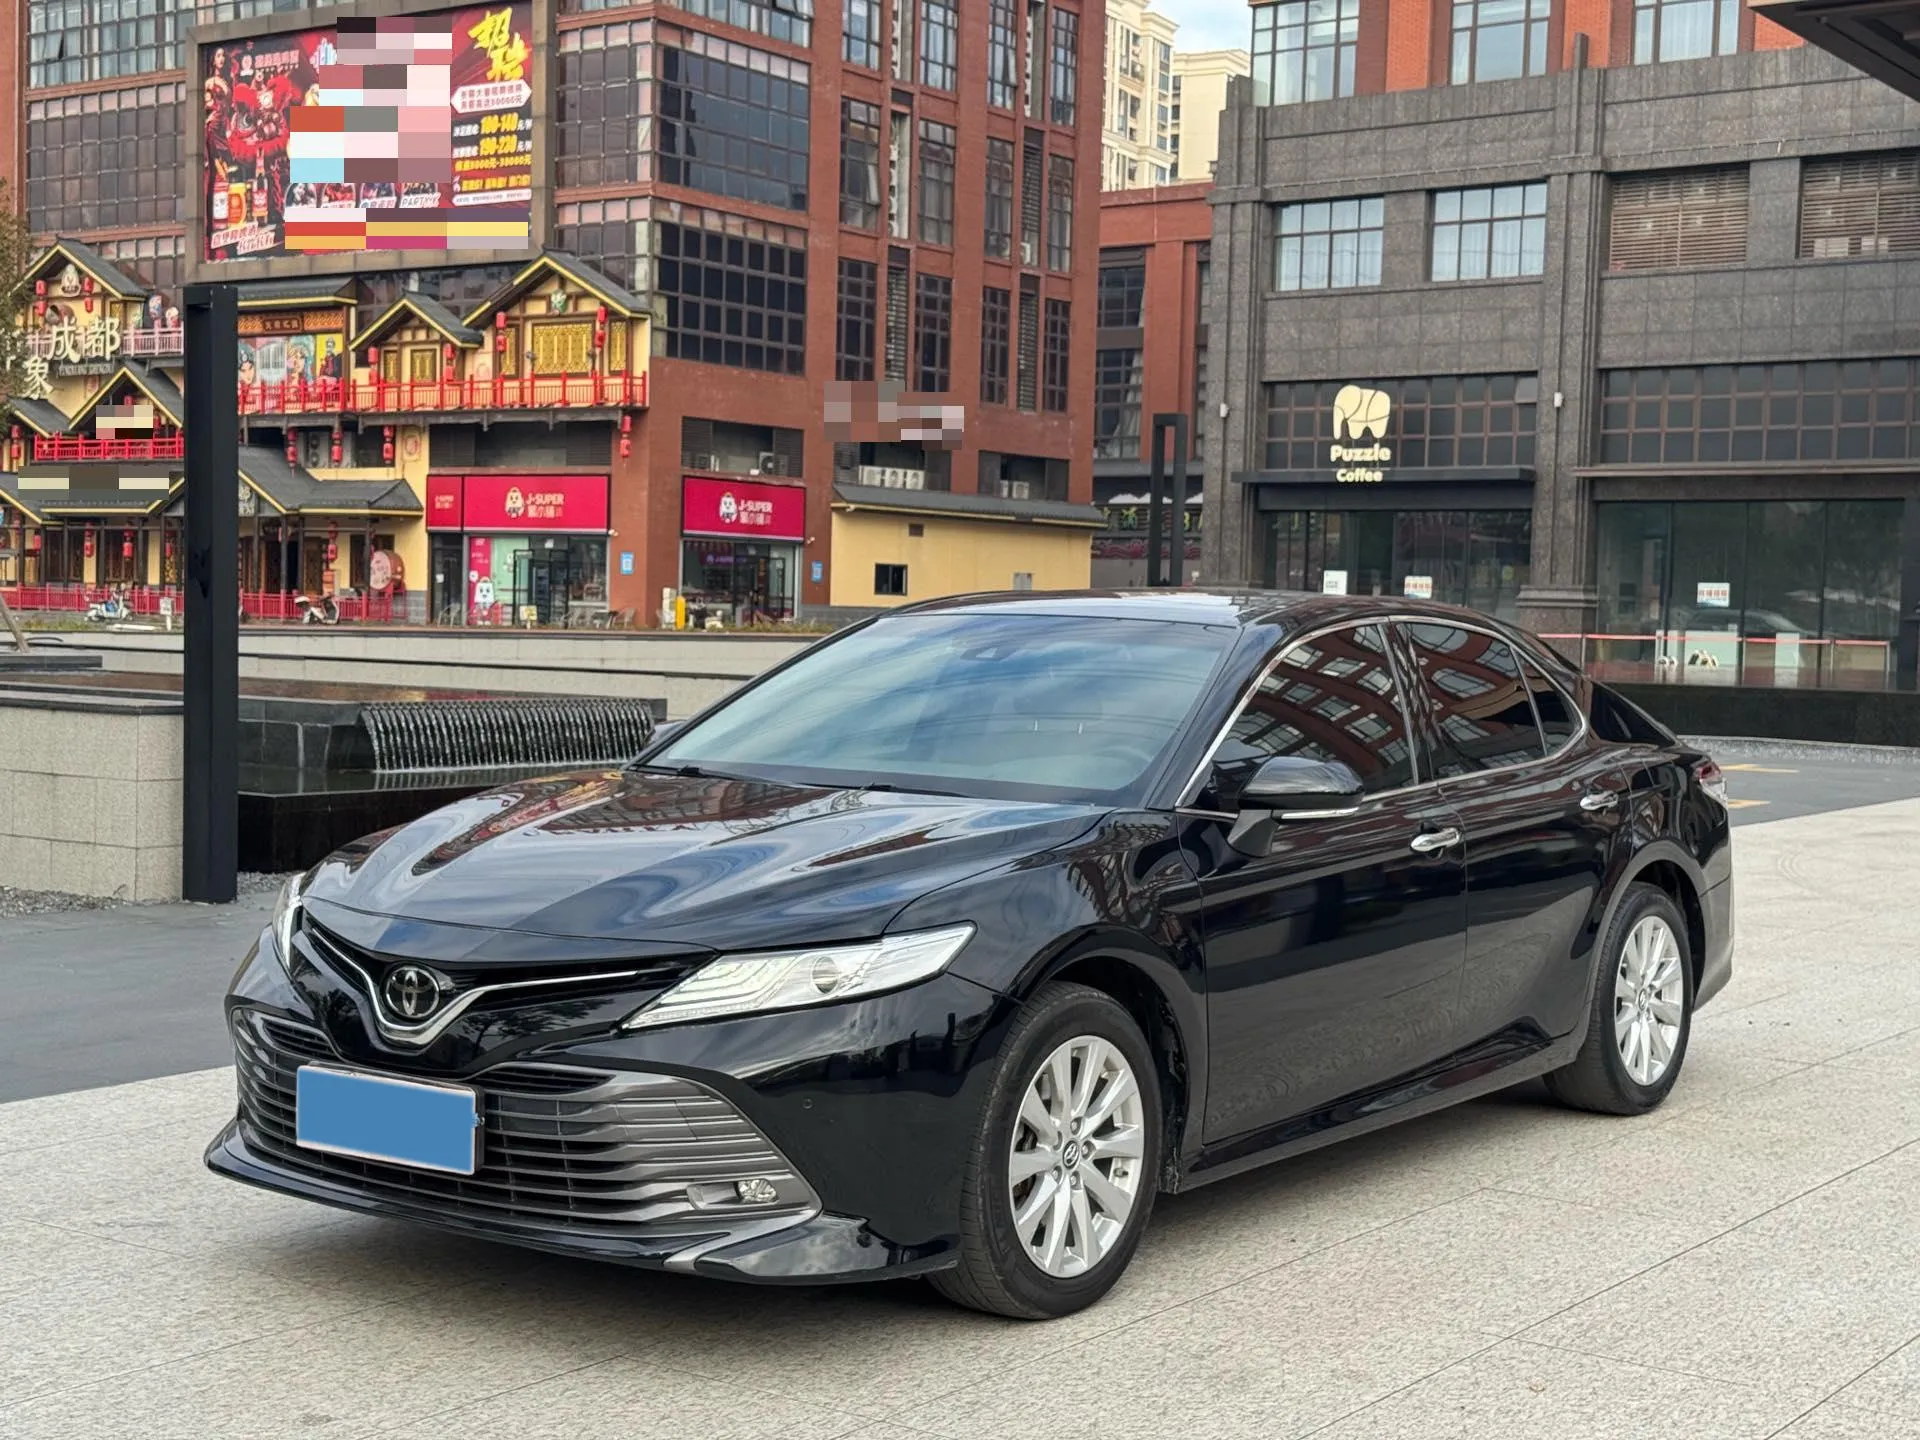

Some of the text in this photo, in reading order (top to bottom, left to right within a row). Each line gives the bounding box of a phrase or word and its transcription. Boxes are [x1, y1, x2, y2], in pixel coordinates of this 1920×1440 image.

[47, 316, 121, 363] 成都
[1330, 443, 1391, 462] Puzzle
[1336, 467, 1384, 482] Coffee
[526, 493, 565, 505] J-SUPER
[738, 499, 773, 513] J-SUPER
